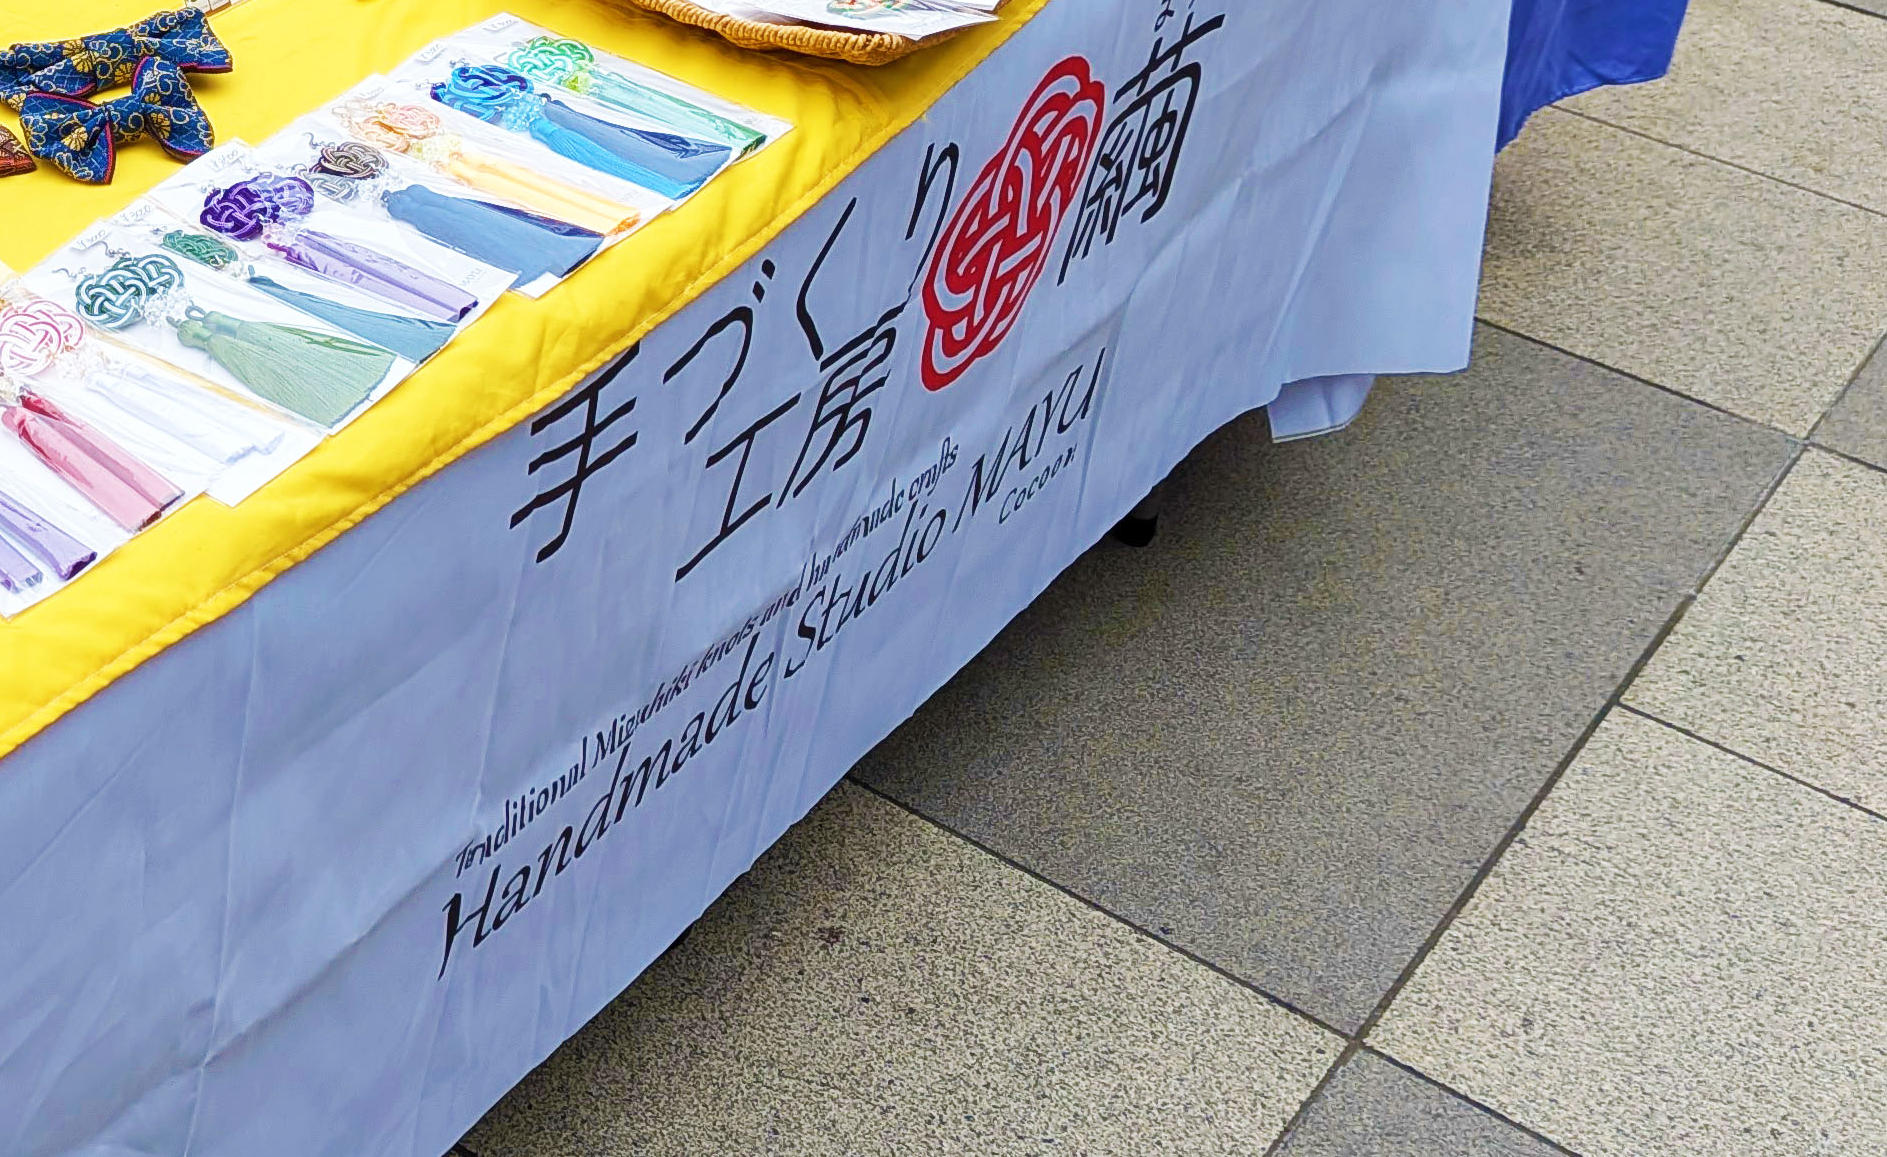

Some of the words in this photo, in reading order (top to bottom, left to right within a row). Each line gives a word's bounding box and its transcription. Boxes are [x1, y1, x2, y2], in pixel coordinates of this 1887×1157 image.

[509, 142, 960, 563] 手づくり
[675, 303, 913, 583] 工房
[999, 443, 1077, 525] Cocoon
[437, 631, 775, 980] Handmade
[784, 499, 946, 679] Studio
[953, 347, 1106, 535] MAYU
